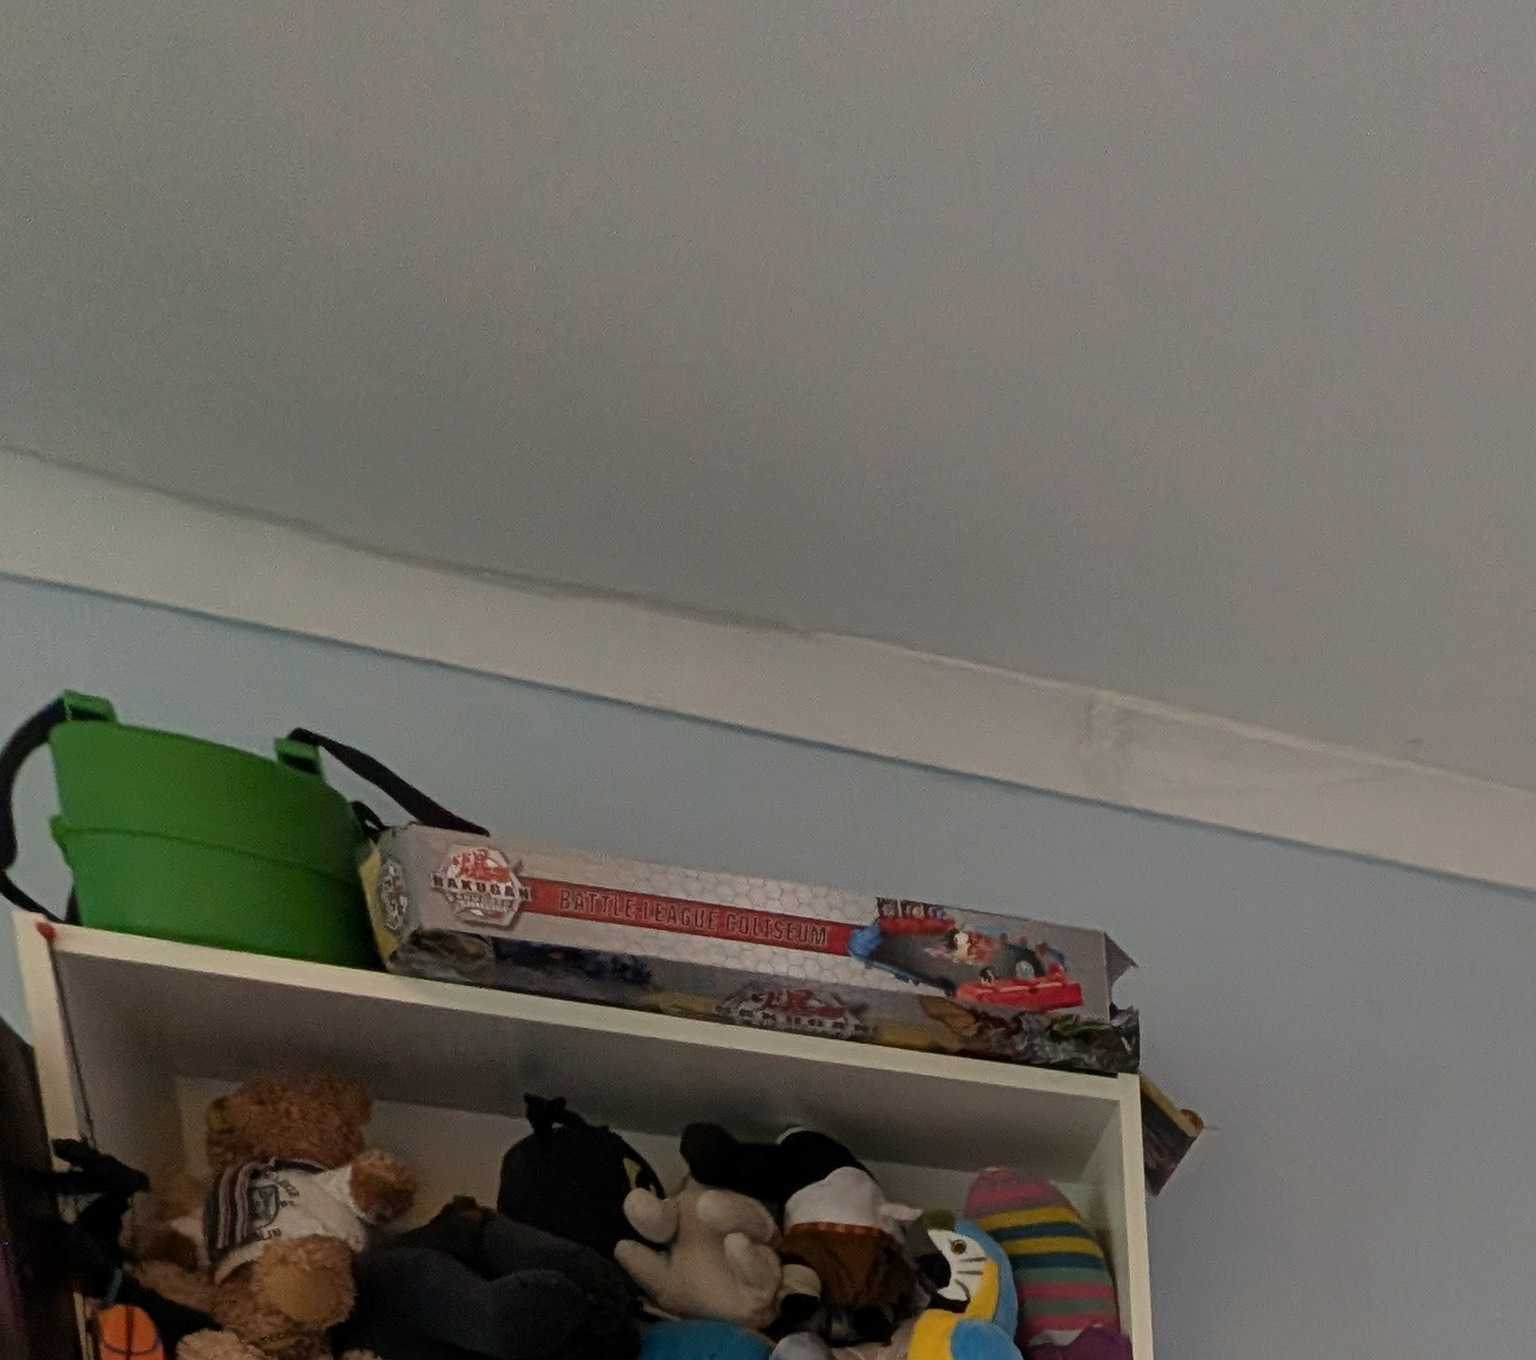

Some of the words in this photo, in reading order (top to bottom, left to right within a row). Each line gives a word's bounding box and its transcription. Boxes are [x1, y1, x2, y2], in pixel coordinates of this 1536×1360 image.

[560, 890, 635, 918] BATTLE
[641, 902, 720, 929] LEAGUE
[724, 912, 829, 947] COLISEUM
